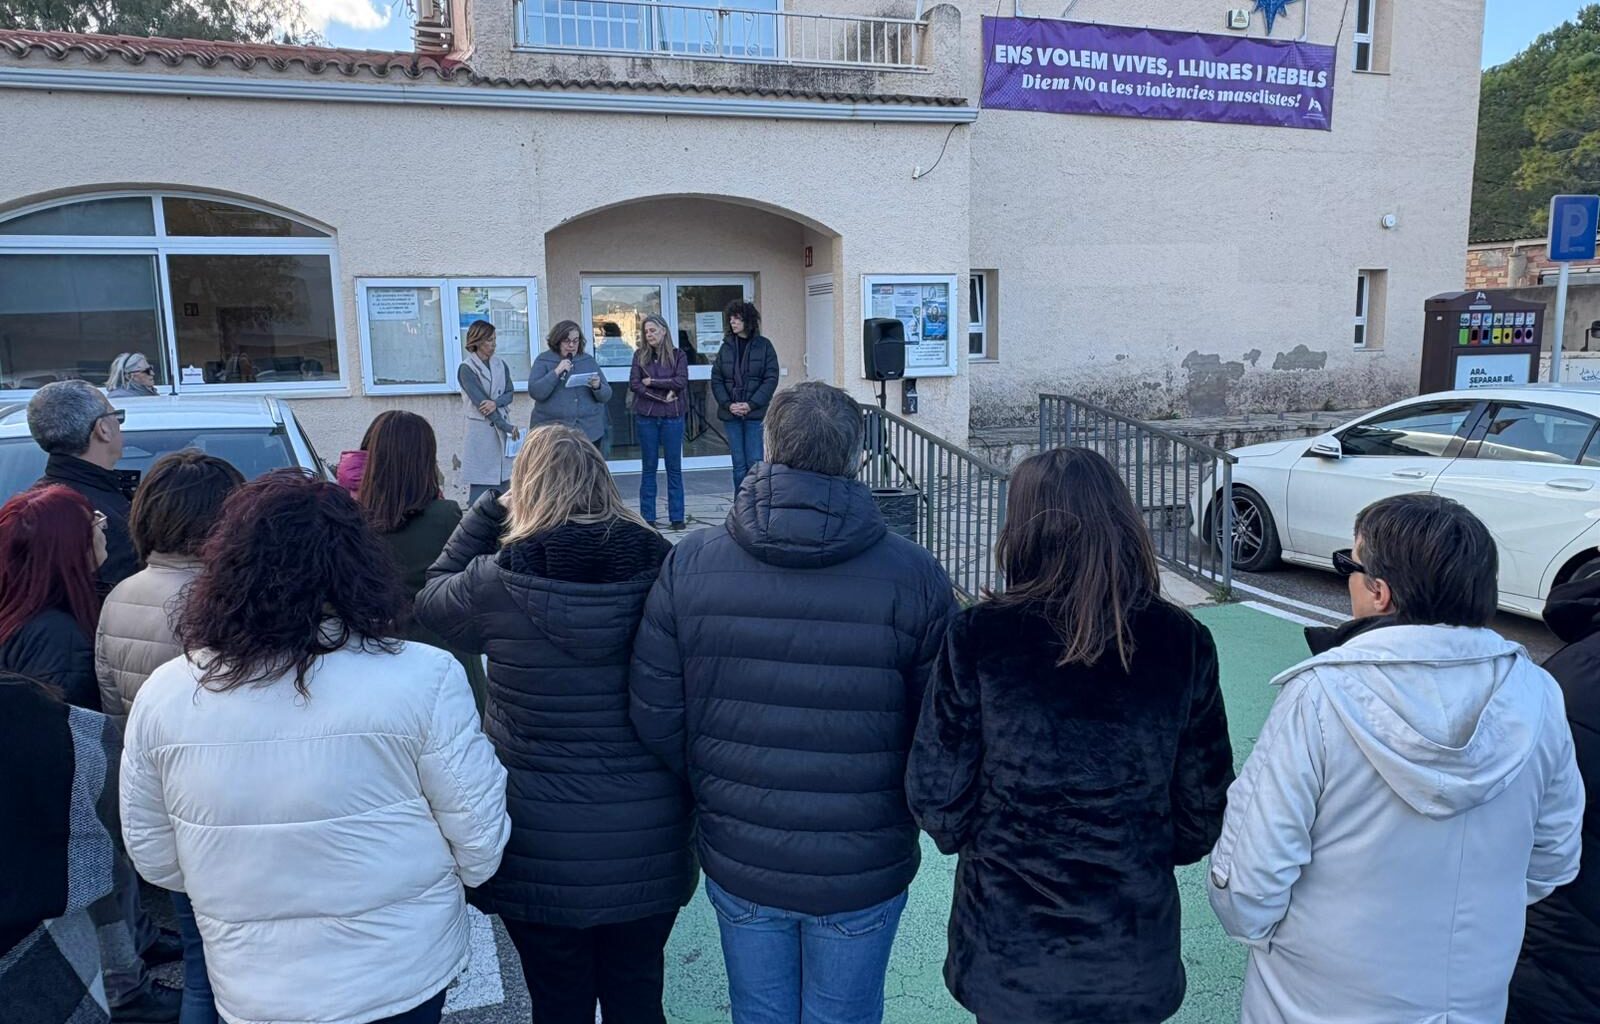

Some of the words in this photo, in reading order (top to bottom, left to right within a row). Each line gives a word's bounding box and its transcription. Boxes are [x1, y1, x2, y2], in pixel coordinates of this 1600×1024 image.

[995, 45, 1032, 65] ENS
[1037, 47, 1108, 70] VOLEM
[1112, 53, 1173, 78] VIVES,
[1178, 59, 1253, 81] LLIURES
[1256, 65, 1263, 81] I
[1266, 67, 1327, 88] REBELS
[1022, 74, 1070, 90] Diem
[1072, 76, 1096, 92] NO
[1098, 82, 1109, 94] a
[1112, 80, 1134, 96] les
[1136, 82, 1215, 100] violències
[1217, 90, 1302, 108] masclistes!
[1560, 203, 1588, 253] P
[1469, 376, 1502, 384] SEPARAR
